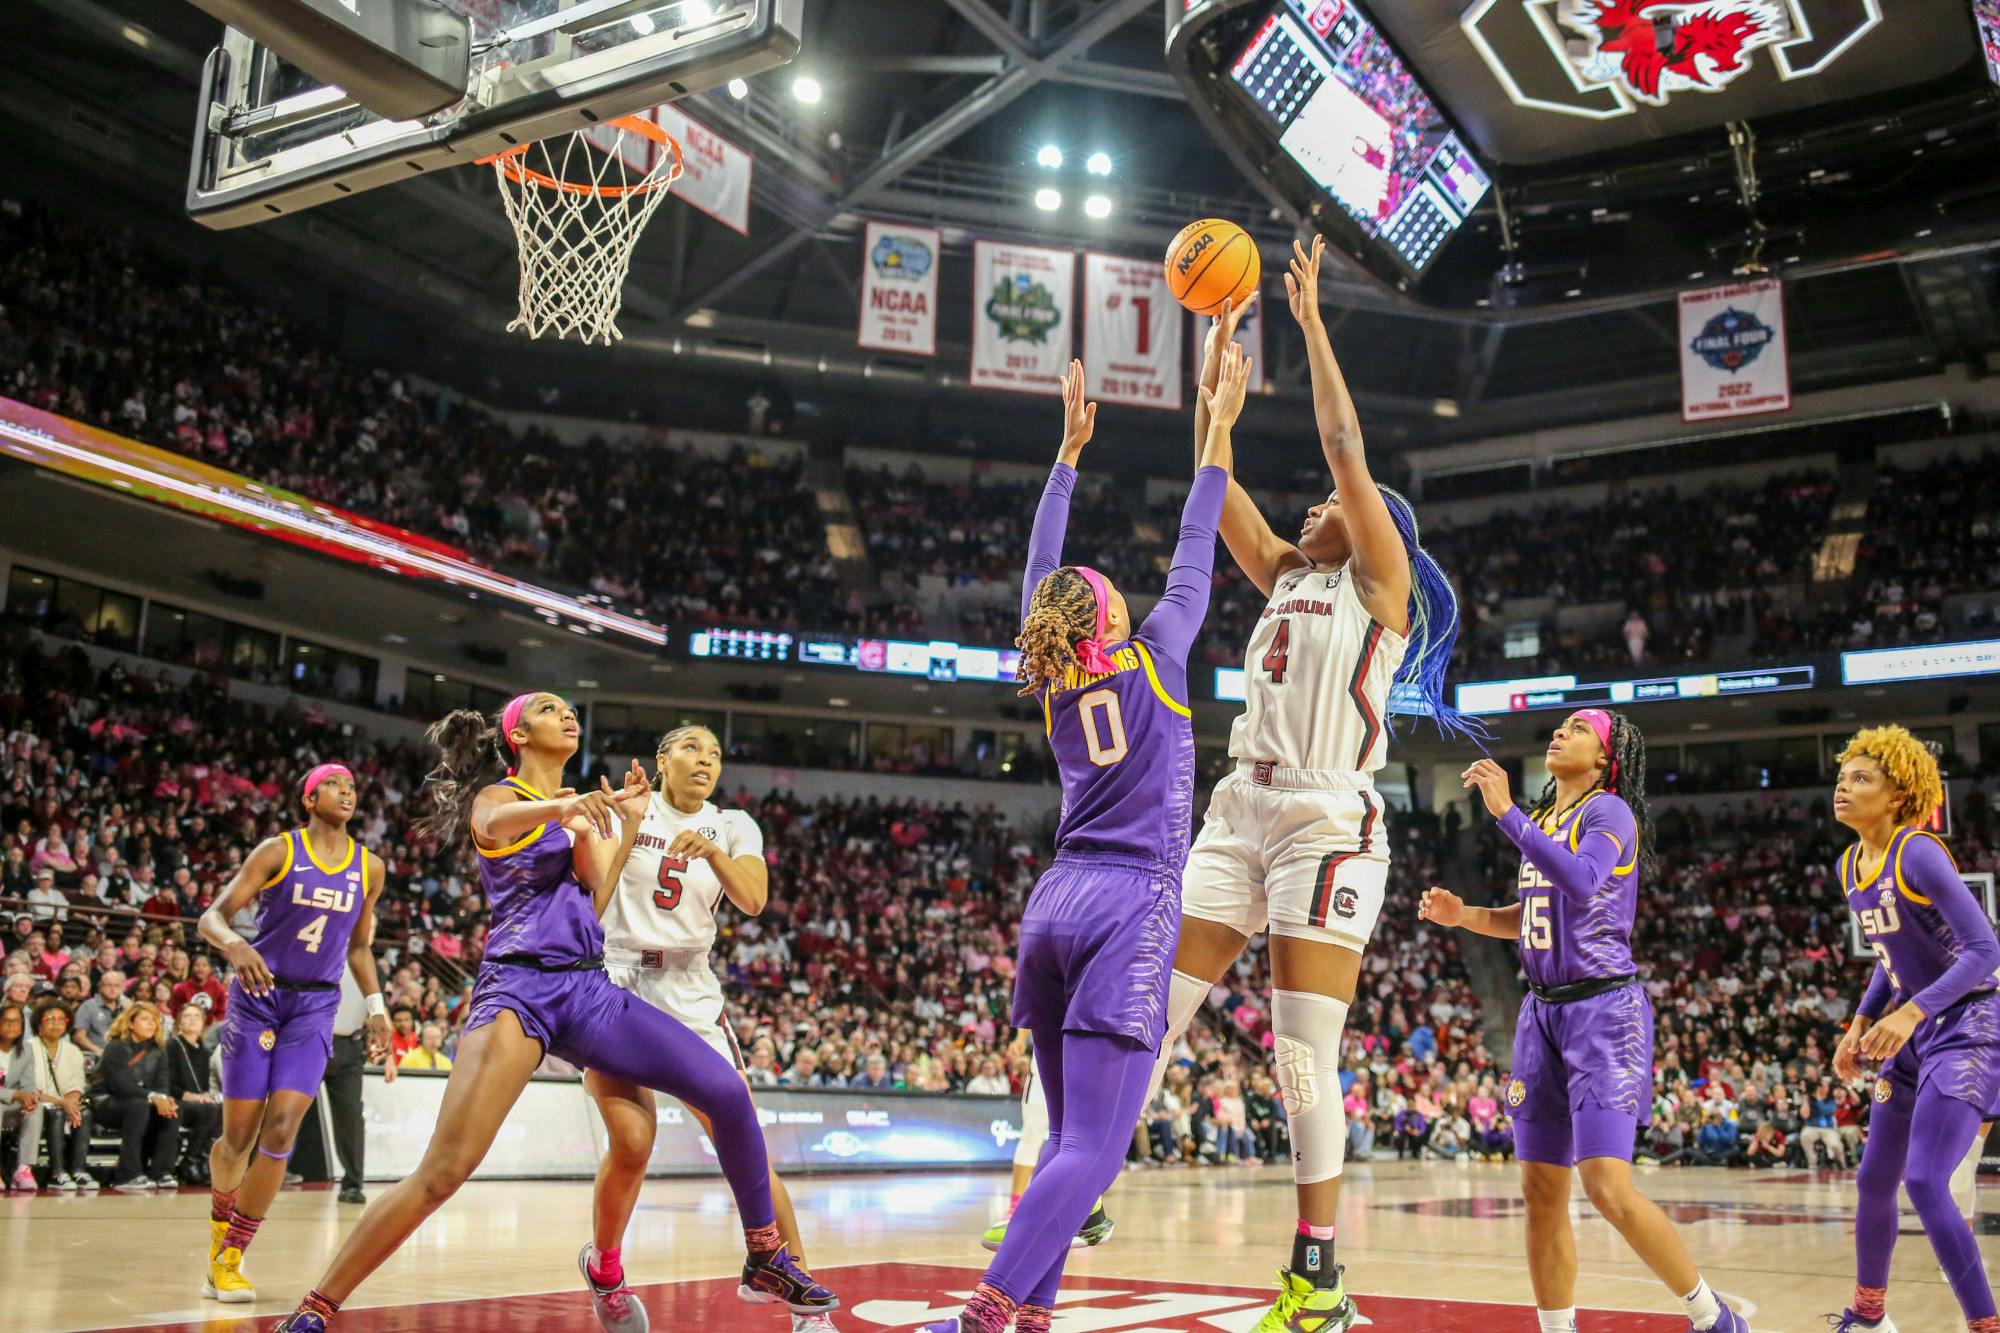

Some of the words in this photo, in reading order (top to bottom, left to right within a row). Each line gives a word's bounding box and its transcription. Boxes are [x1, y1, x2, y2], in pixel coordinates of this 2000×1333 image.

[686, 124, 725, 166] NCAA
[1177, 233, 1216, 276] NCAA
[871, 286, 927, 315] NCAA
[1696, 336, 1730, 350] FINAL
[1733, 329, 1767, 345] FOUR
[1005, 354, 1038, 369] 2017
[1718, 382, 1753, 397] 2022
[1276, 600, 1333, 616] CAROLINA
[1262, 619, 1290, 683] 4
[1078, 688, 1129, 767] 0
[632, 833, 666, 850] SOUTH
[292, 883, 355, 913] LSU
[653, 856, 688, 911] 5
[297, 914, 329, 954] 4
[1521, 896, 1553, 950] 45
